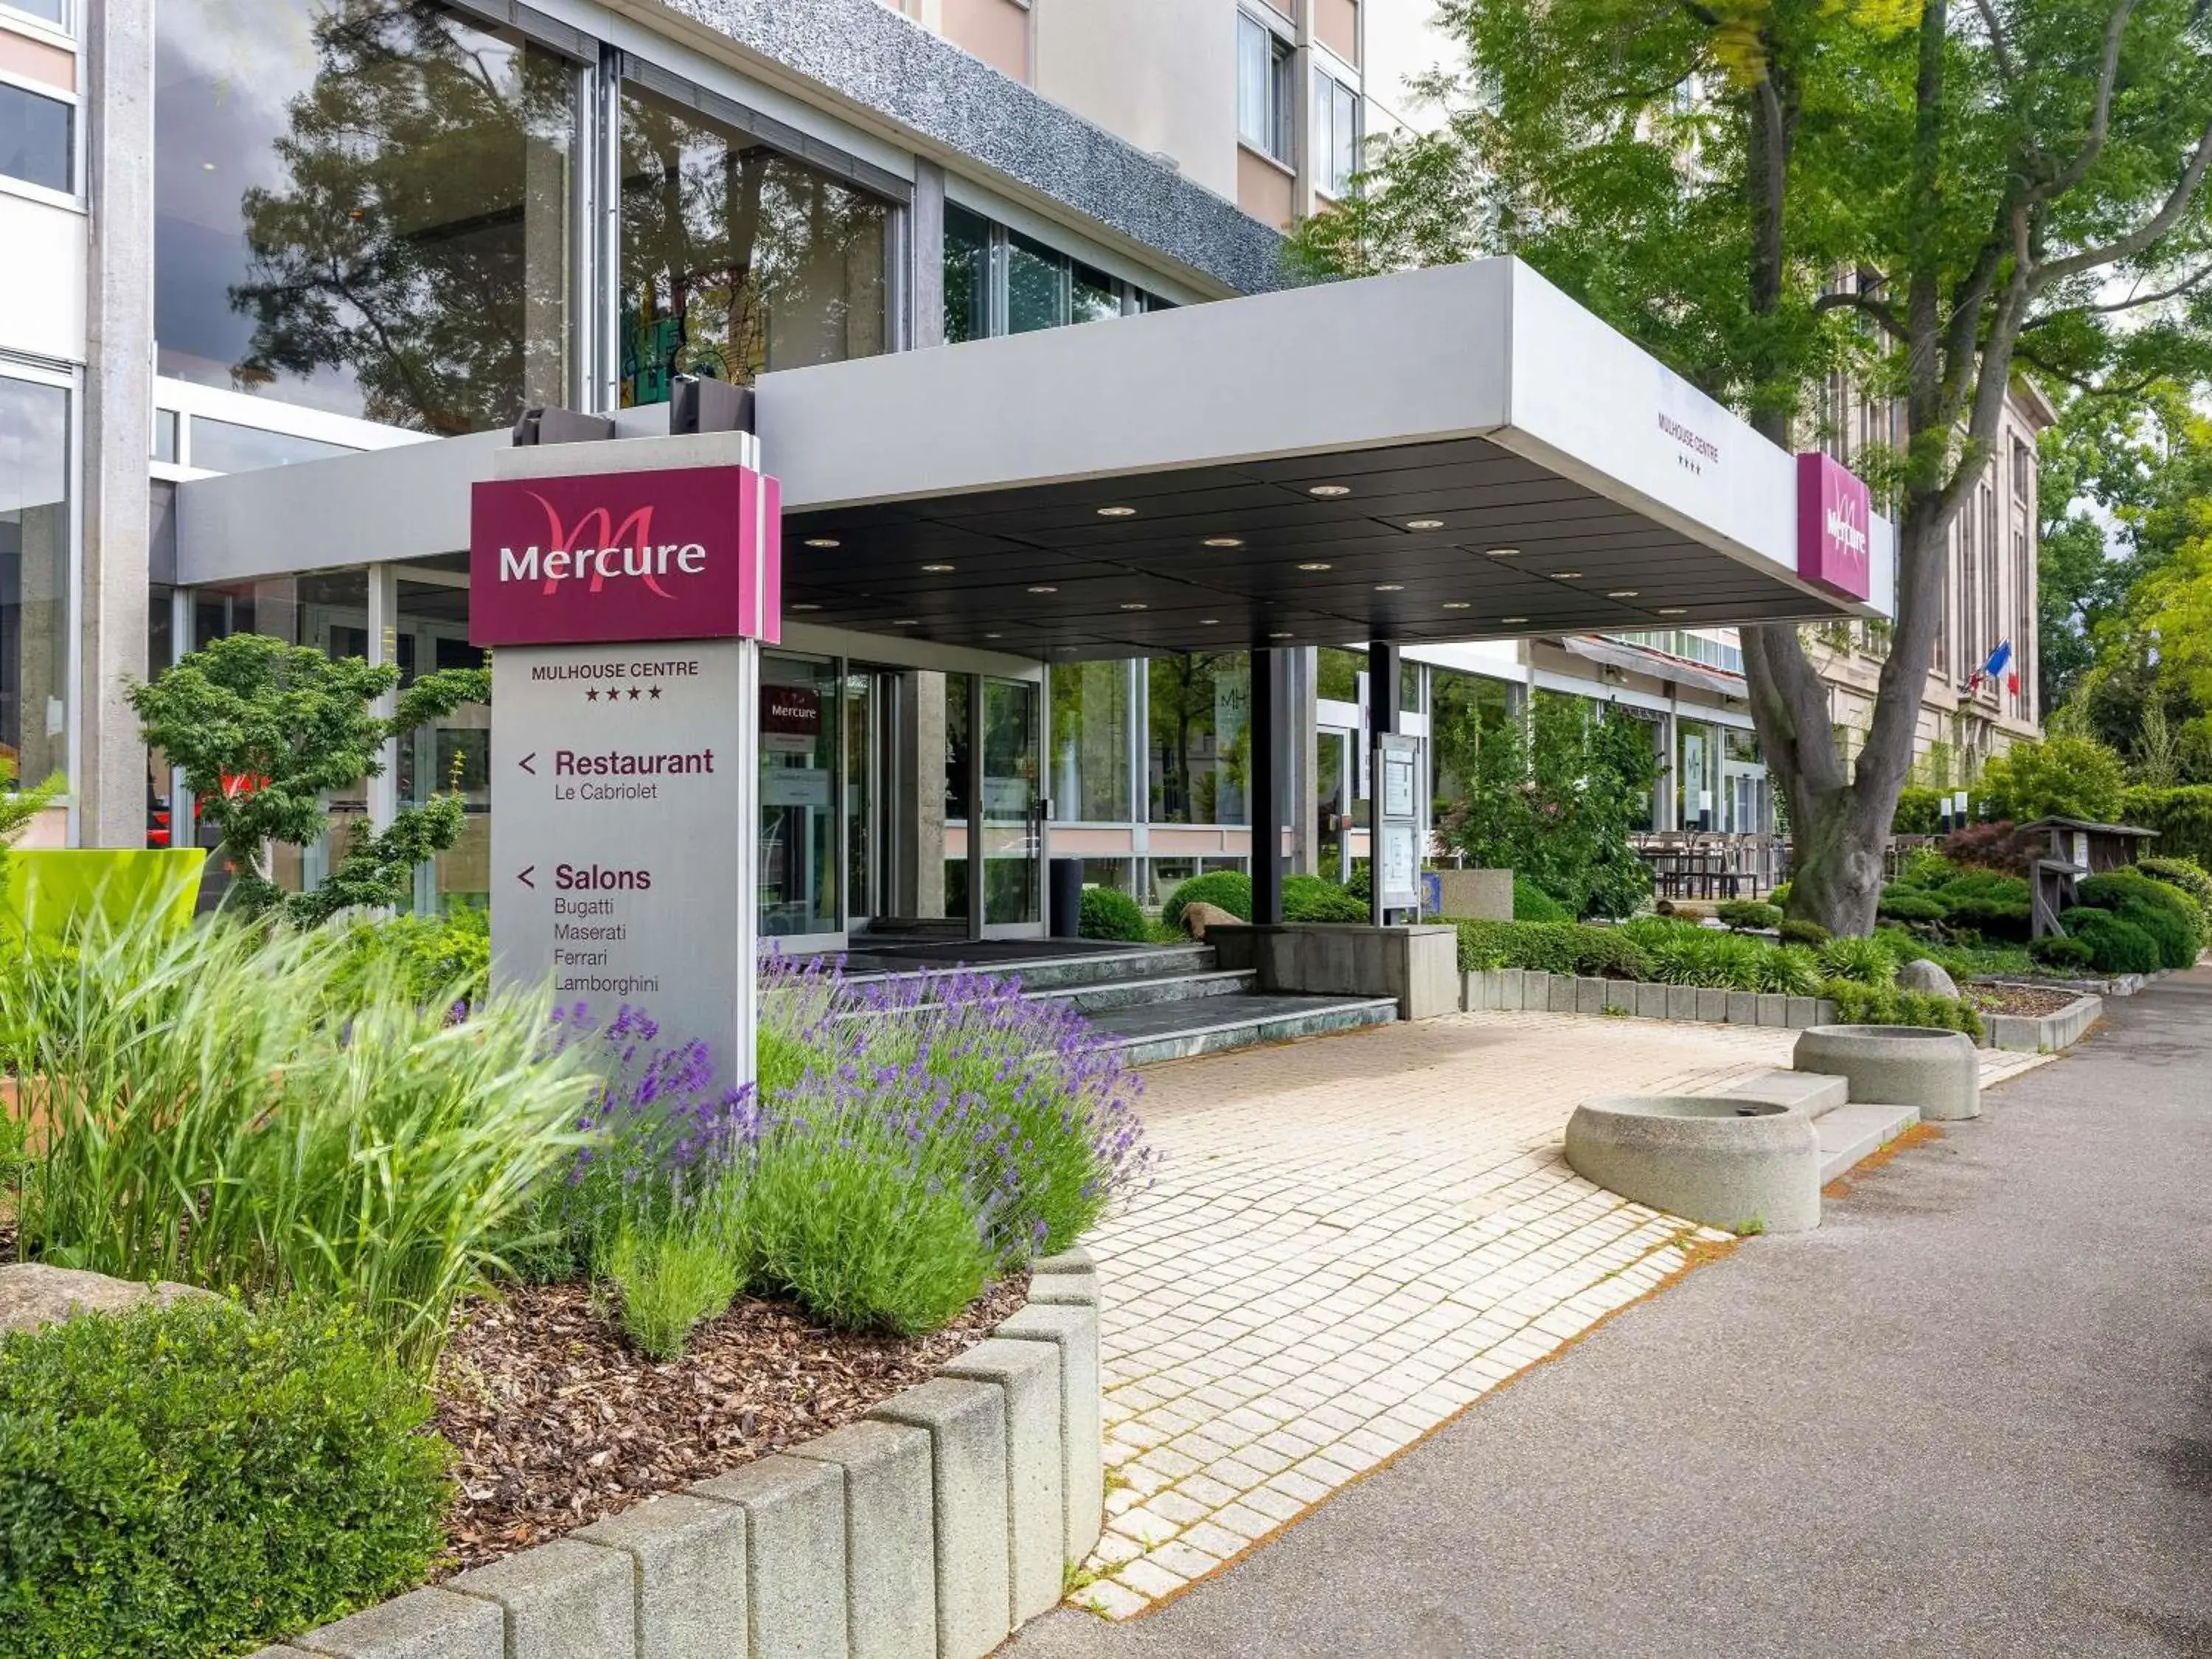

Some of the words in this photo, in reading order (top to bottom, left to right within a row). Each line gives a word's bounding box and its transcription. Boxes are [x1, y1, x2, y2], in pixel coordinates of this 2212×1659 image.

[1658, 412, 1694, 448] MULHOUSE
[1694, 436, 1719, 464] CENTRE
[1827, 508, 1866, 554] Mercure
[499, 542, 706, 582] Mercure
[532, 664, 626, 681] MULHOUSE
[630, 661, 699, 677] CENTRE
[772, 704, 817, 719] Mercure
[555, 749, 714, 776] Restaurant
[555, 784, 575, 800] Le
[580, 782, 658, 800] Cabriolet
[555, 864, 652, 890] Salons
[554, 897, 614, 918] Bugatti
[554, 923, 627, 941] Maserati
[554, 949, 608, 966] Ferrari
[555, 975, 659, 996] Lamborghini
